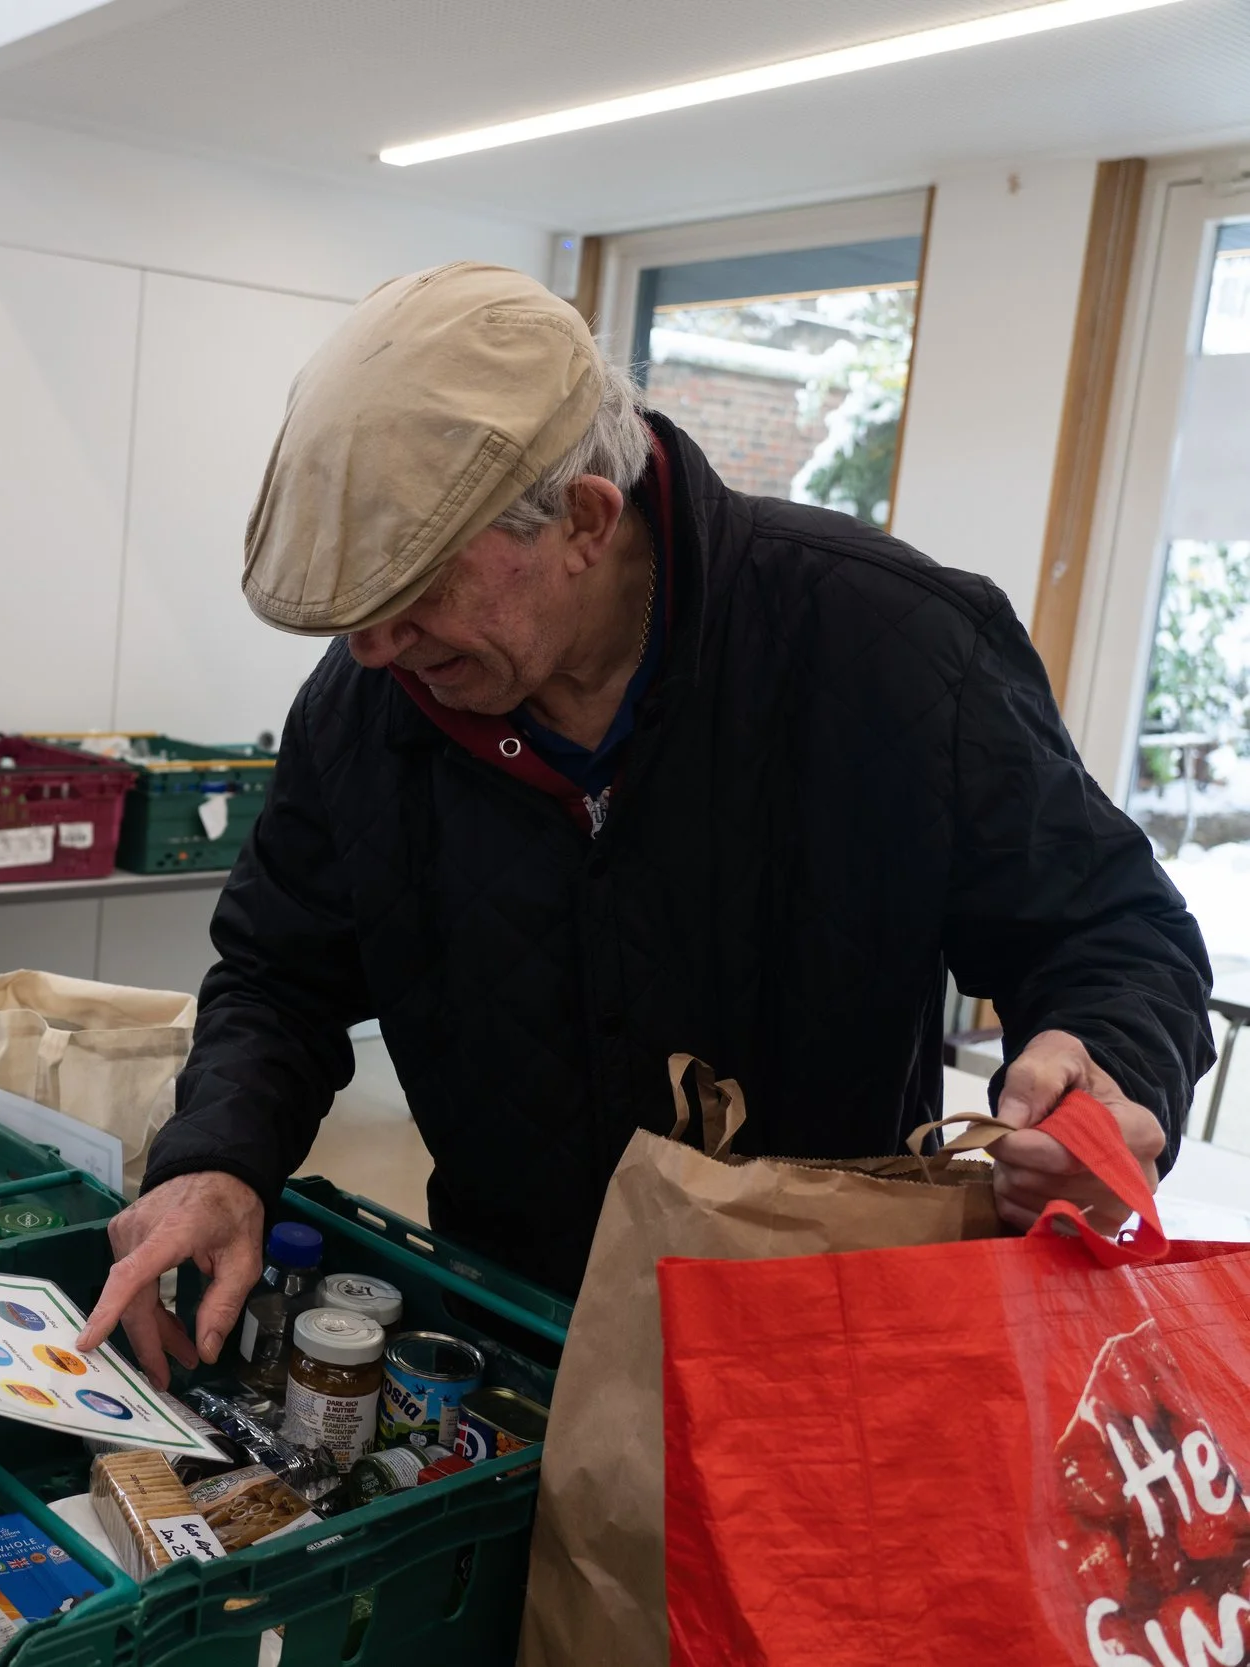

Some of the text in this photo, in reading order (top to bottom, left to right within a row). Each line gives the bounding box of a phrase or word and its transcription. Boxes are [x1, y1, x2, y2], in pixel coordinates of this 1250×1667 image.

[384, 1378, 422, 1421] osia
[1106, 1415, 1250, 1539] He
[29, 1543, 47, 1552] MILK
[172, 1543, 191, 1557] 23
